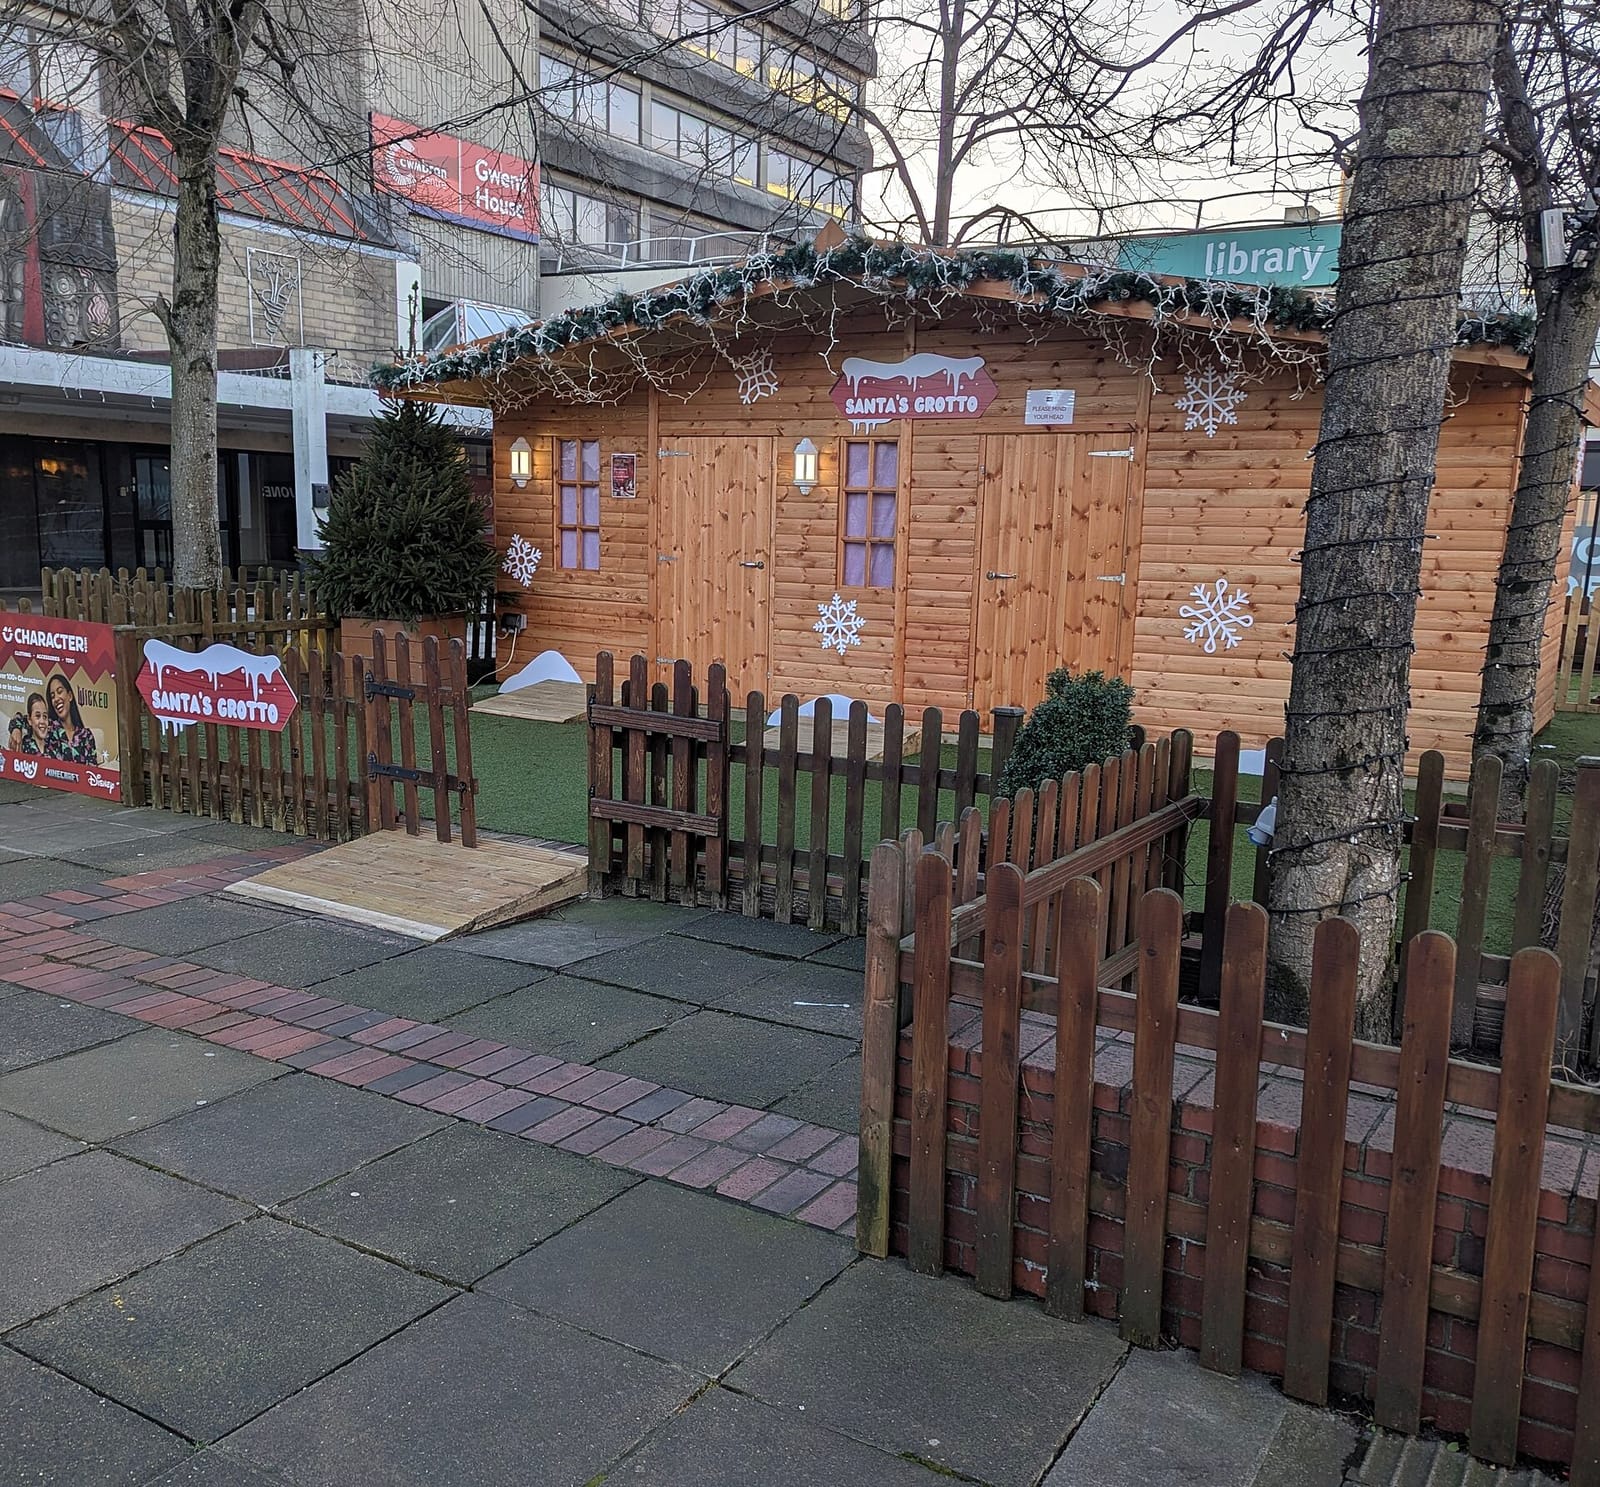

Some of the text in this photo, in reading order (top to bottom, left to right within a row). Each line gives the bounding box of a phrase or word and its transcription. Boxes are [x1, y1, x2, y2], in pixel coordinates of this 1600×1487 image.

[475, 158, 527, 193] Gwent
[475, 185, 525, 219] House
[1204, 241, 1326, 281] library
[845, 393, 979, 415] SANTA'S GROTTO
[77, 685, 109, 709] WICKED
[151, 690, 279, 724] SANTA'S GROTTO
